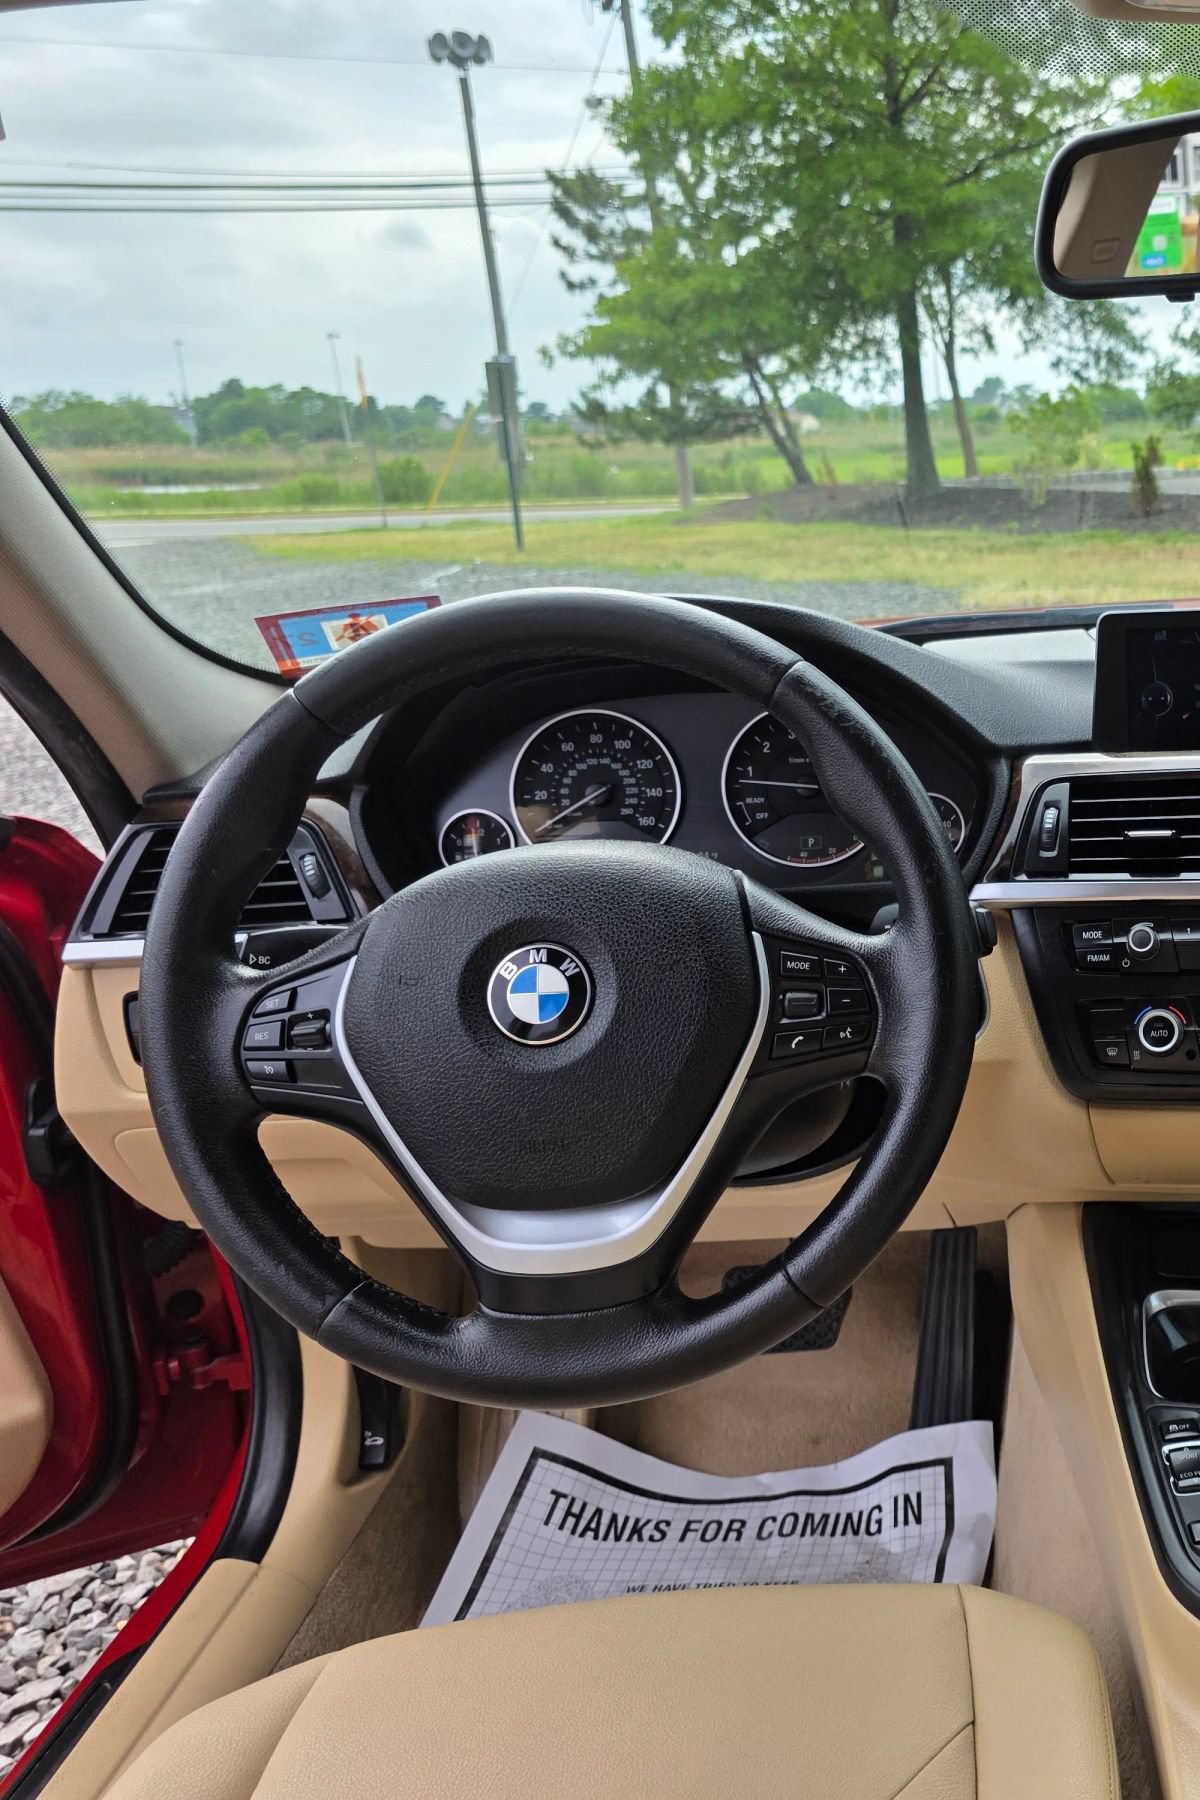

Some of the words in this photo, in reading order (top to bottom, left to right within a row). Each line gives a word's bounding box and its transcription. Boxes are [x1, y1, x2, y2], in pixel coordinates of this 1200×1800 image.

[590, 734, 602, 744] 80
[561, 742, 574, 752] 60
[614, 740, 631, 750] 100
[762, 742, 771, 753] 2
[540, 764, 554, 773] 40
[636, 759, 653, 769] 120
[746, 766, 753, 777] 1
[534, 790, 548, 800] 20
[646, 787, 662, 797] 140
[638, 816, 656, 826] 160
[808, 838, 815, 848] P
[1082, 930, 1103, 939] MODE
[258, 956, 271, 965] BC
[1087, 954, 1110, 962] FM/AM
[499, 948, 580, 980] BMW
[786, 960, 811, 970] MODE
[266, 998, 280, 1010] SET
[254, 1032, 269, 1041] RES
[1150, 1030, 1169, 1038] AUTO
[1180, 1471, 1193, 1479] ECO
[543, 1489, 672, 1542] THANKS
[678, 1519, 747, 1542] FOR
[756, 1504, 883, 1541] COMING
[893, 1492, 922, 1528] IN
[626, 1583, 650, 1594] WE
[652, 1582, 691, 1593] HAVE
